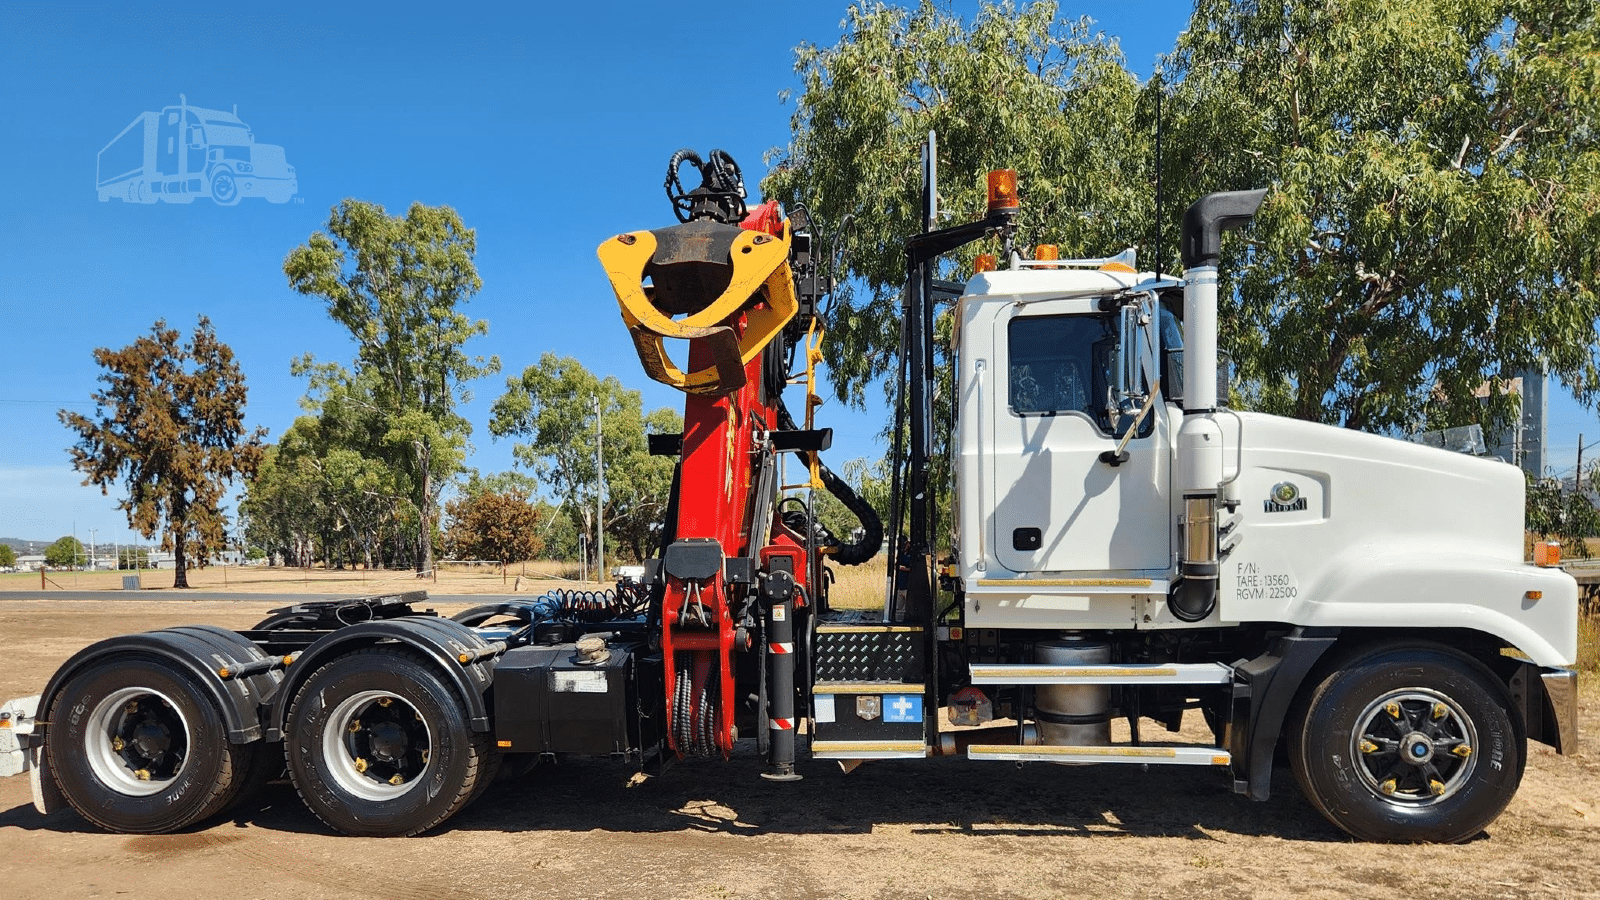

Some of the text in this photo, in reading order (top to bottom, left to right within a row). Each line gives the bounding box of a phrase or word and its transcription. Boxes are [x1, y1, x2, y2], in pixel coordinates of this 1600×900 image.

[1263, 498, 1307, 513] TRIDENT
[1264, 574, 1290, 586] 13560
[1269, 587, 1298, 599] 22500
